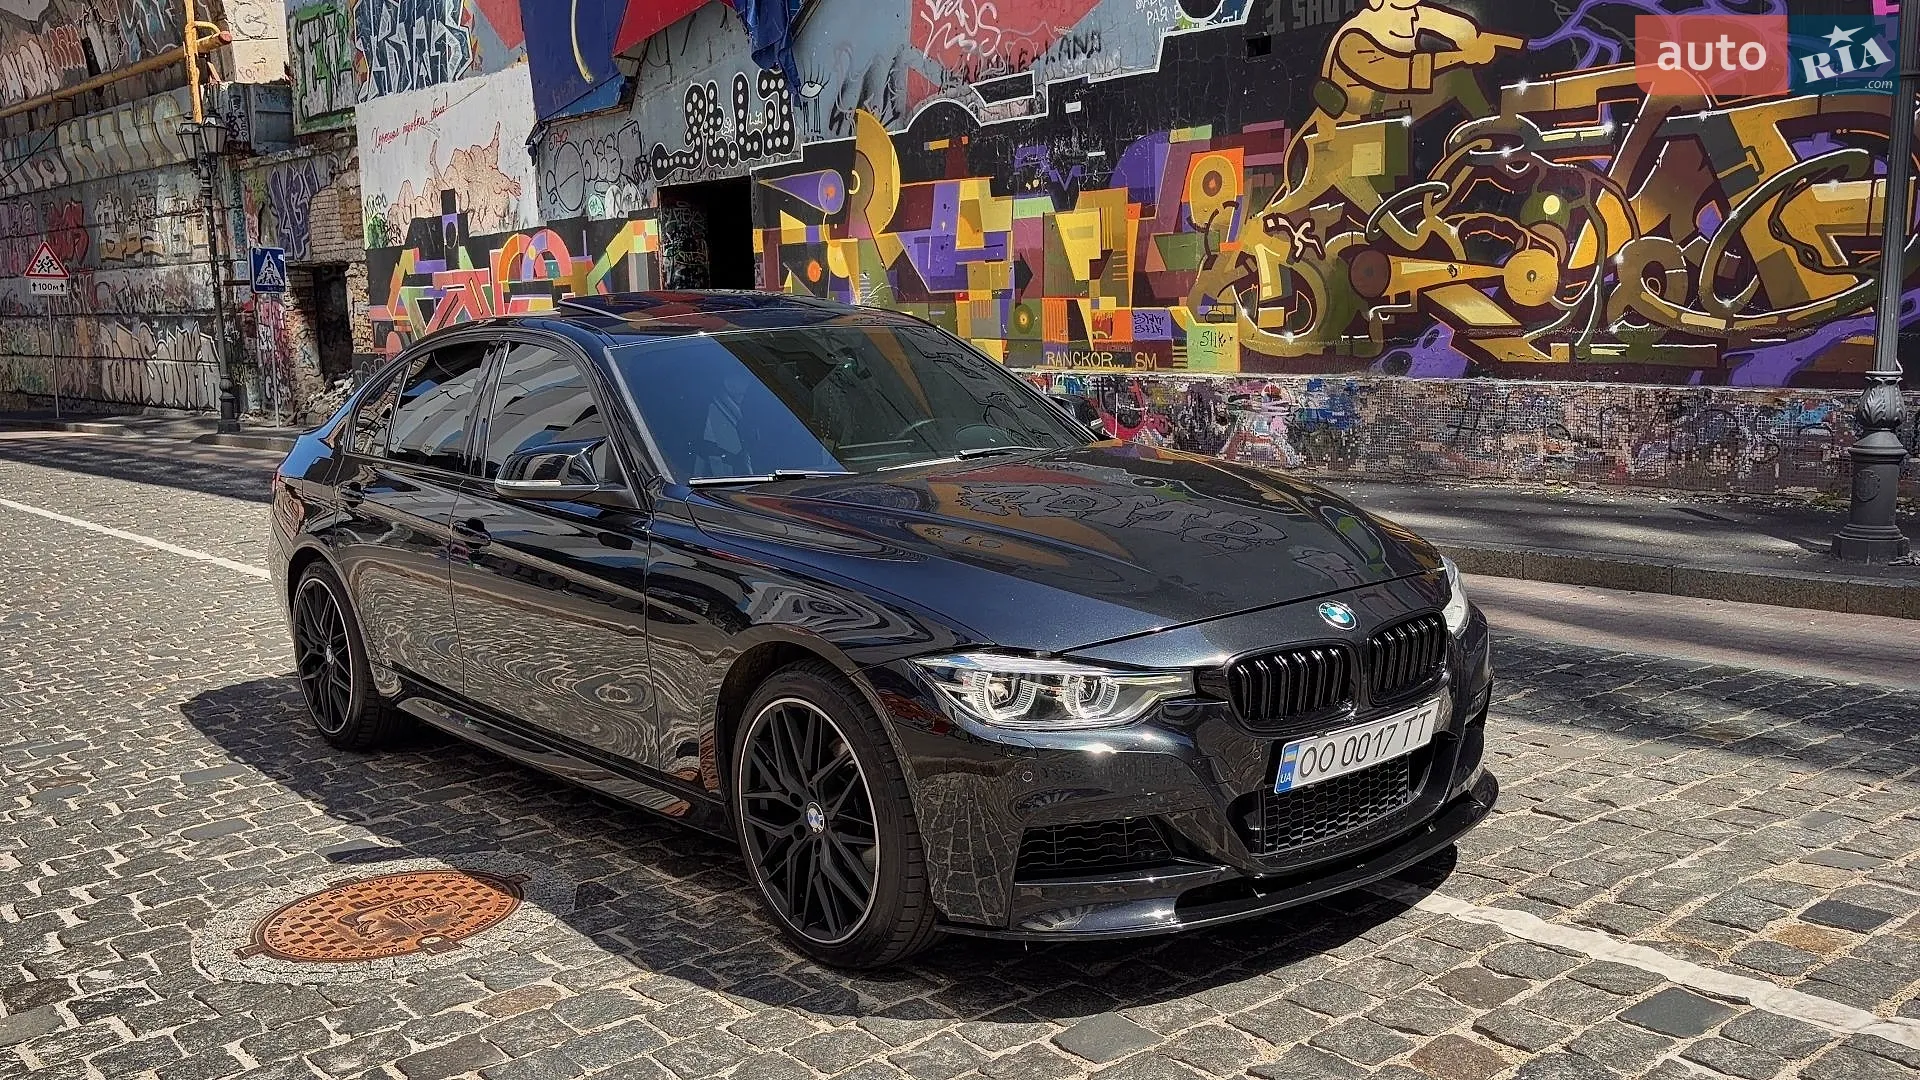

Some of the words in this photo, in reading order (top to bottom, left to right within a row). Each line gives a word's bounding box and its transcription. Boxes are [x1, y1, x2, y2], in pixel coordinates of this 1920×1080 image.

[1135, 352, 1157, 371] SM
[1341, 723, 1399, 767] 0017
[1402, 709, 1433, 749] TT
